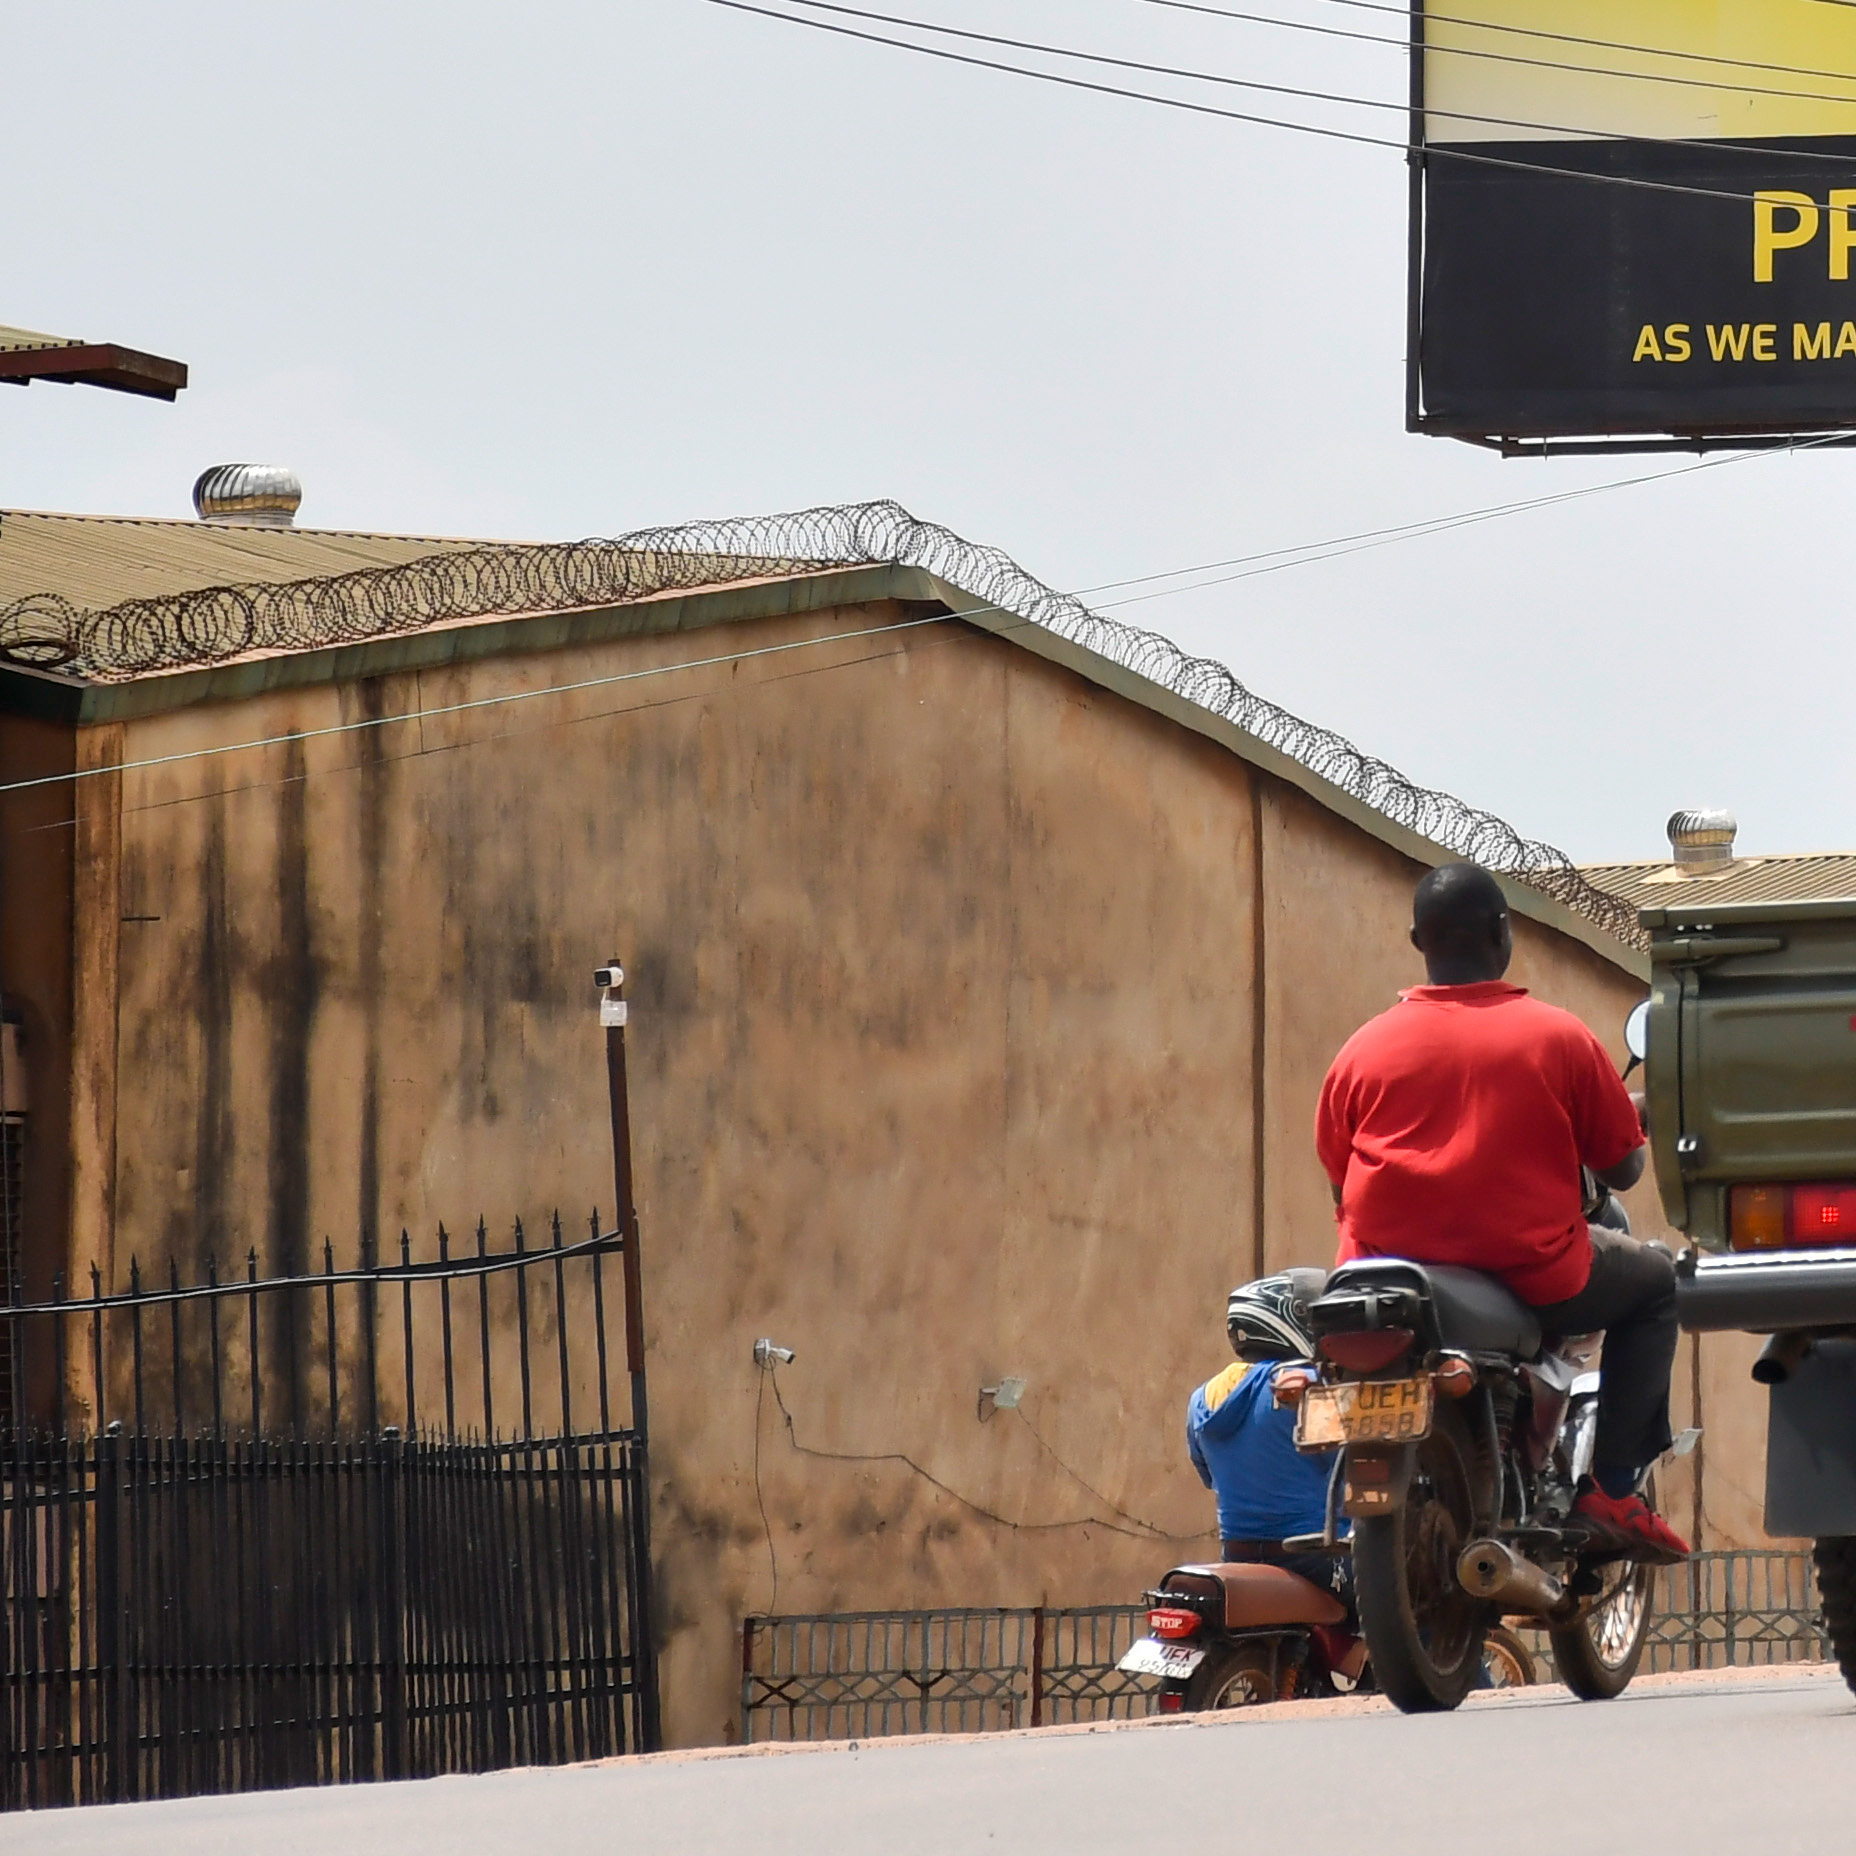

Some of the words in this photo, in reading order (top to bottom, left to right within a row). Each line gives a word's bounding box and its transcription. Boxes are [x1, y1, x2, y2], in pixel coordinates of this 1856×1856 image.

[1633, 323, 1691, 362] AS
[1705, 322, 1777, 361] WE
[1358, 1380, 1421, 1411] UEH
[1150, 1615, 1183, 1629] STOP
